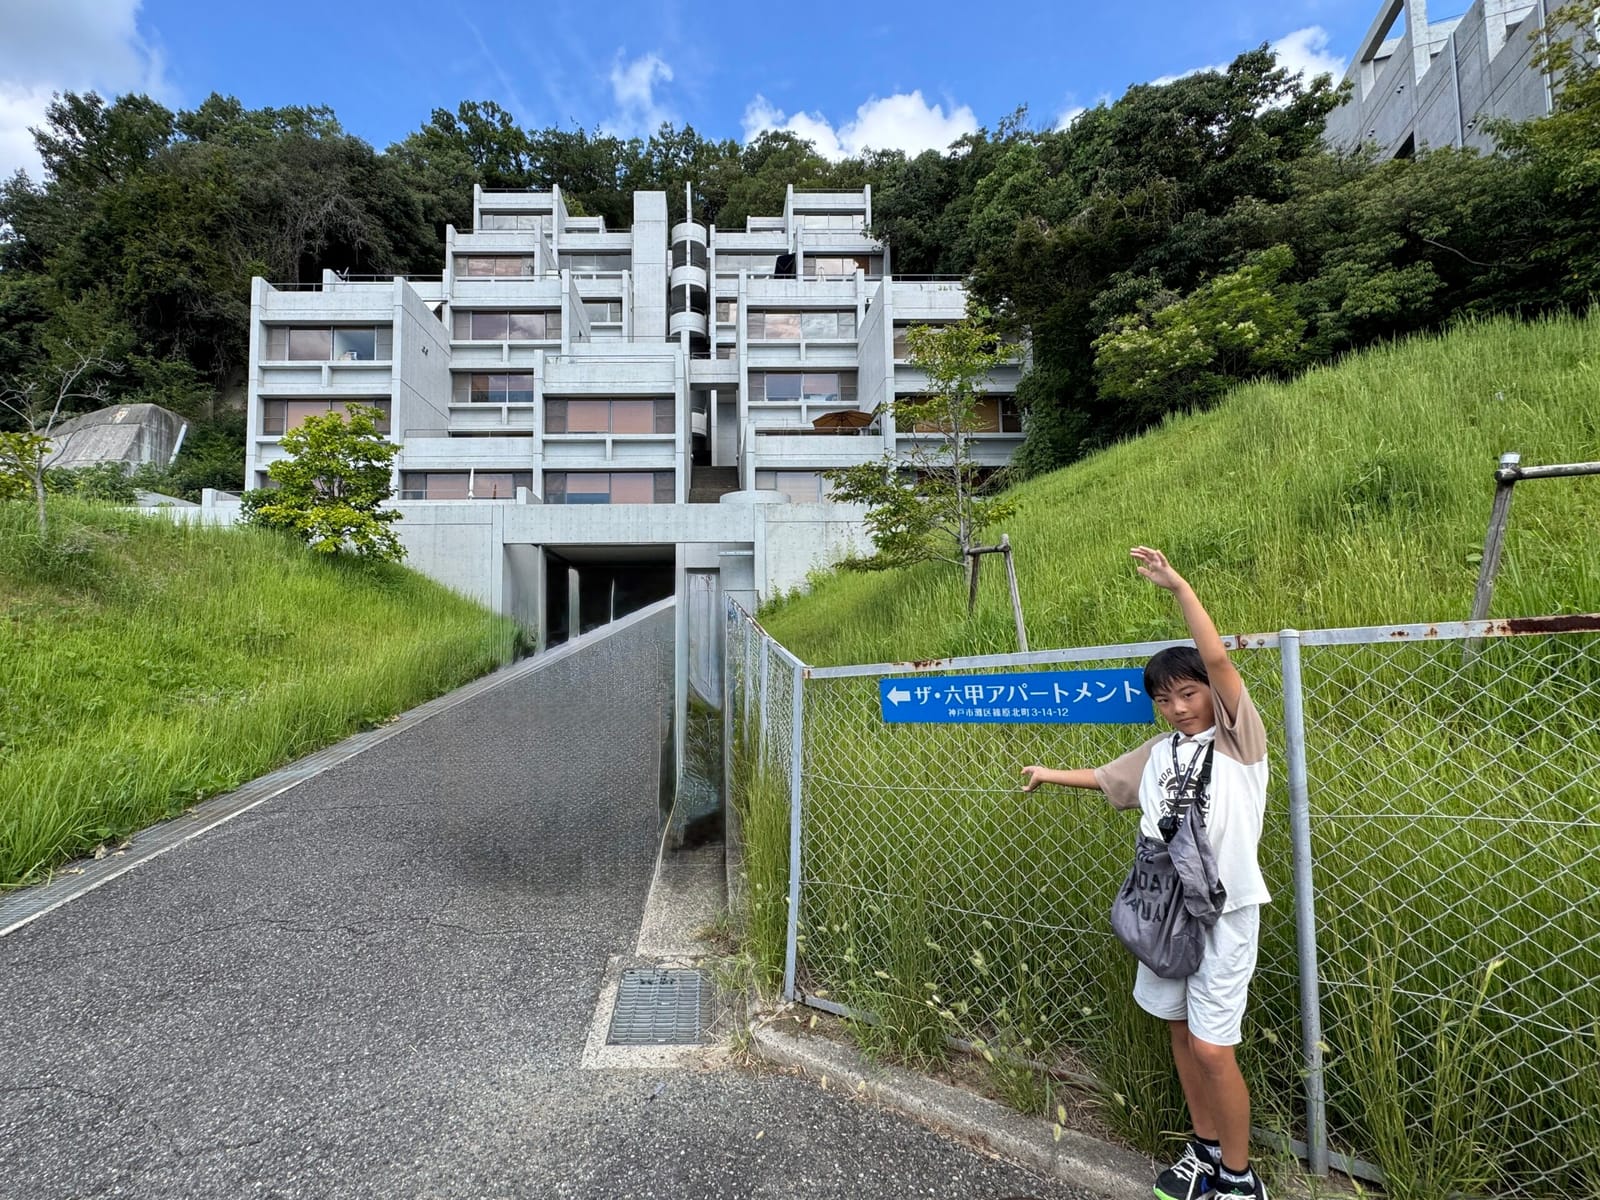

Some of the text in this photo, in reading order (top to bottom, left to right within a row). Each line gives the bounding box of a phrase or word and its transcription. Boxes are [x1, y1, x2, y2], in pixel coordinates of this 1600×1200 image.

[913, 680, 1142, 706] ザ・六甲アパートメント
[1158, 763, 1186, 787] WORD
